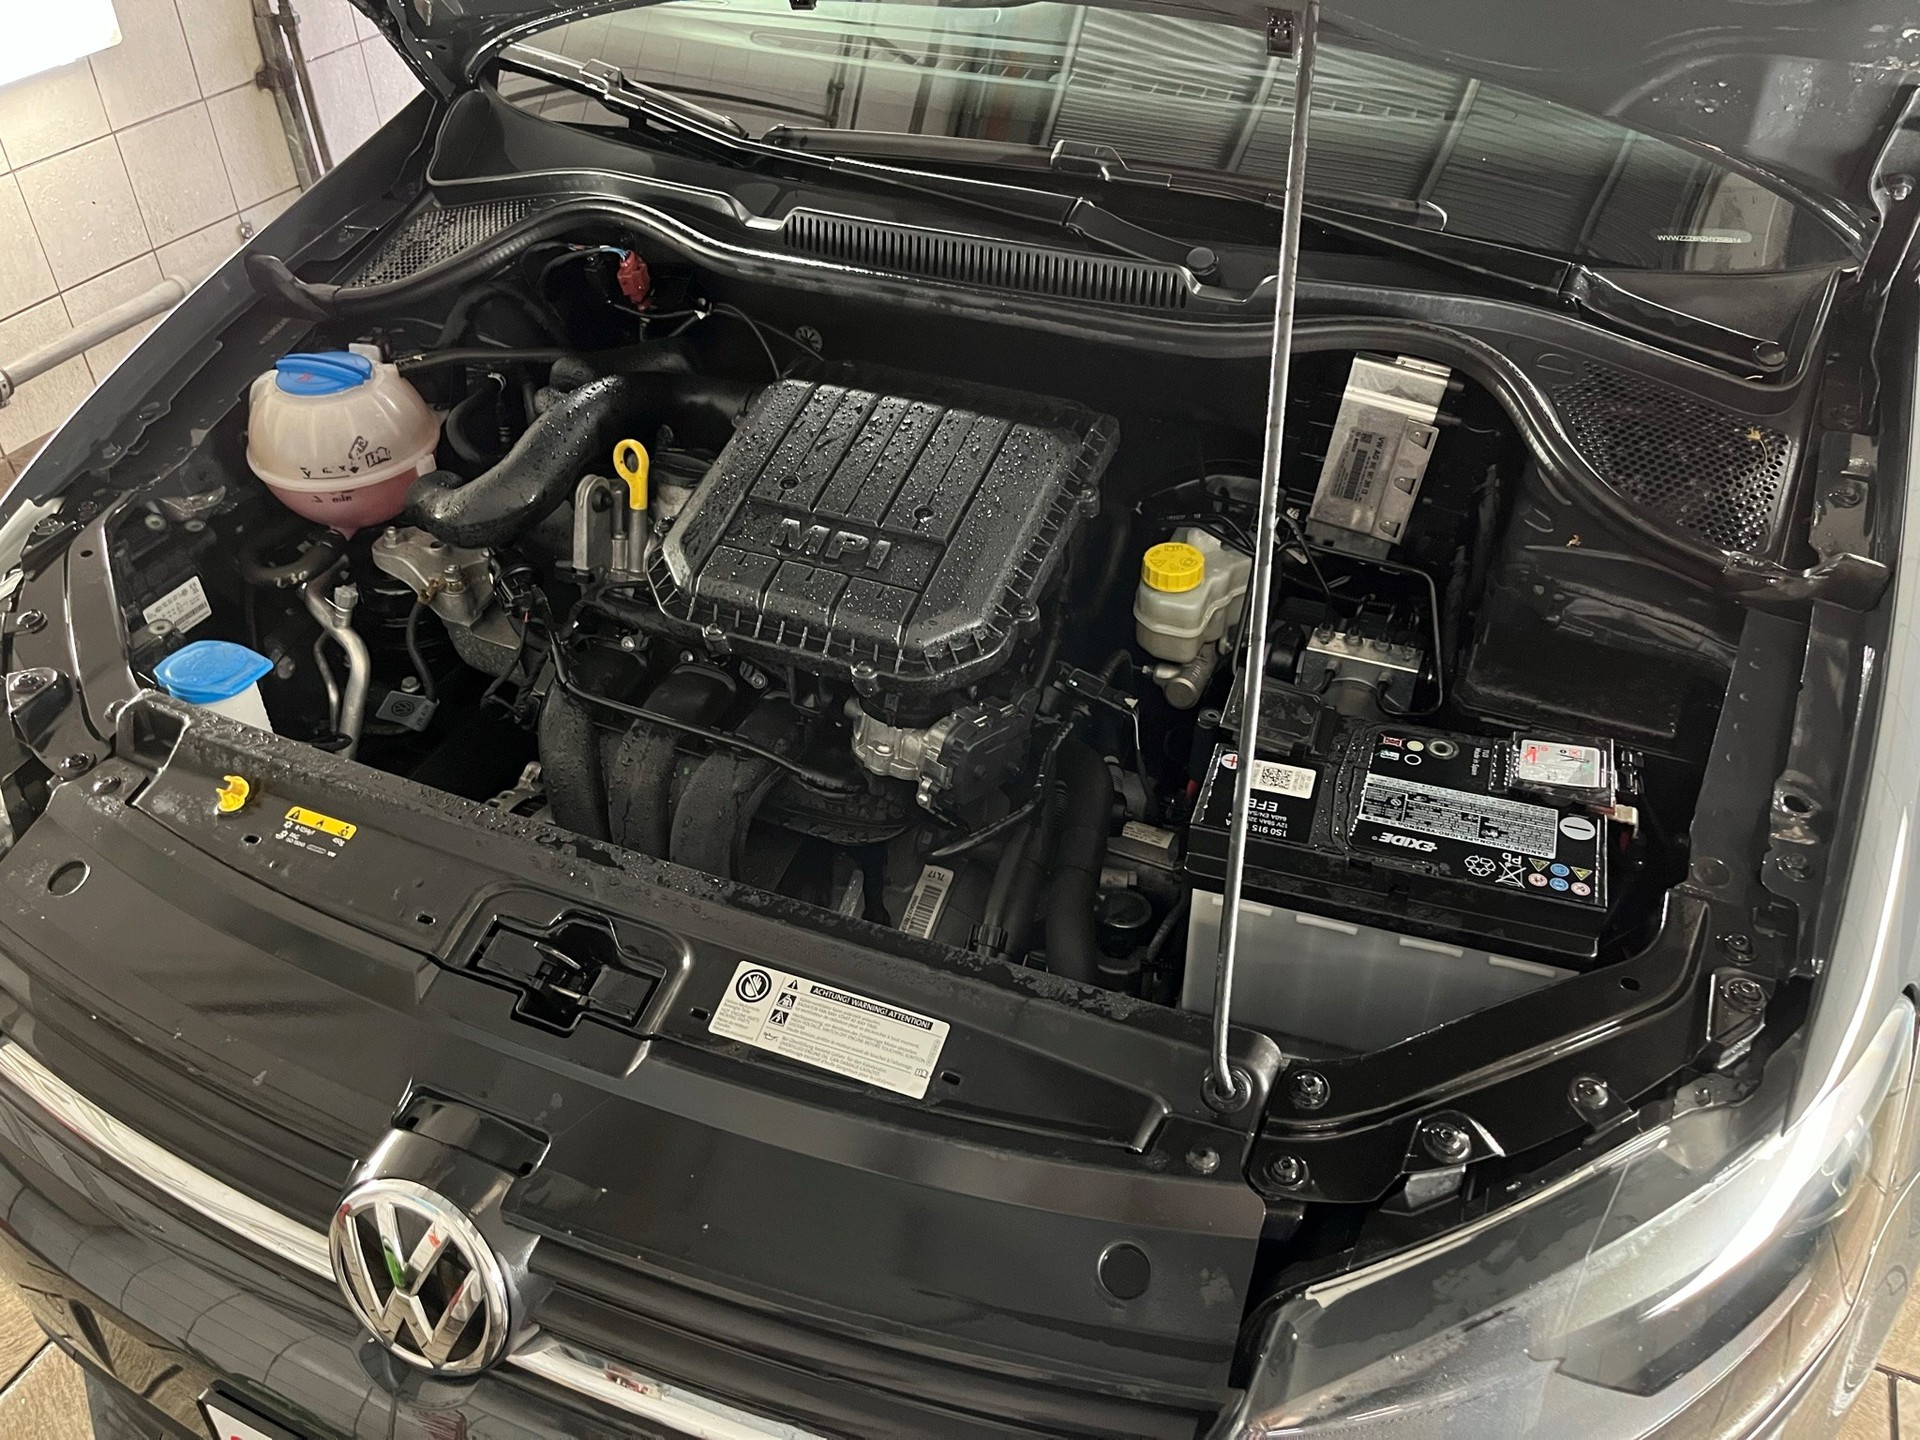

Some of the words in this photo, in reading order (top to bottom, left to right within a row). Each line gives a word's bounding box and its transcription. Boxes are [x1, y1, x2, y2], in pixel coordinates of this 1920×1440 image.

[769, 518, 892, 570] MPI
[1252, 824, 1268, 834] 915
[1378, 832, 1438, 853] EXIDE
[1502, 851, 1523, 866] Pb
[927, 870, 945, 881] 7L17
[812, 986, 850, 1003] ACHTUNG!
[849, 998, 889, 1015] WARNING!
[887, 1009, 930, 1028] ATTENTION!
